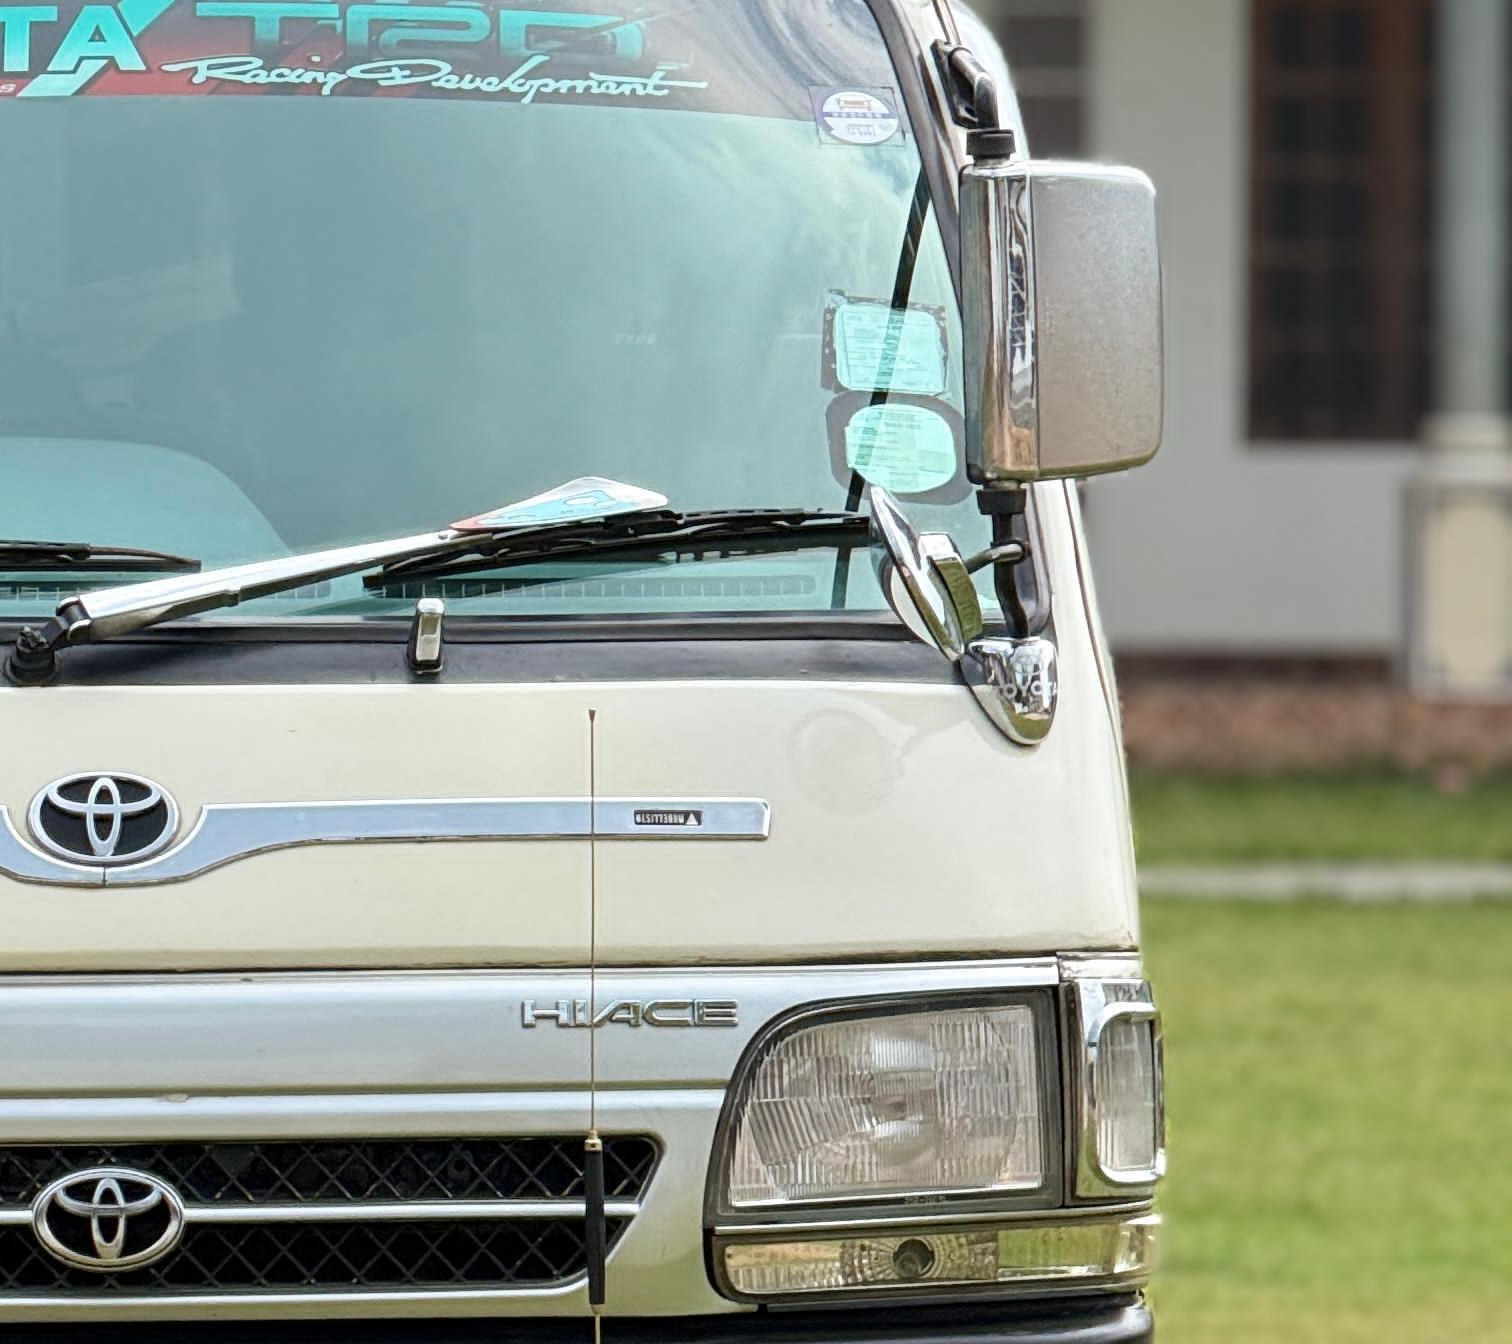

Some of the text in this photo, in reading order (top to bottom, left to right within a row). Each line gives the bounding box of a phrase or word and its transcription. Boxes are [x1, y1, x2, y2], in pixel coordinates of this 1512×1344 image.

[161, 55, 707, 104] Racing Development
[521, 999, 738, 1028] HIACE
